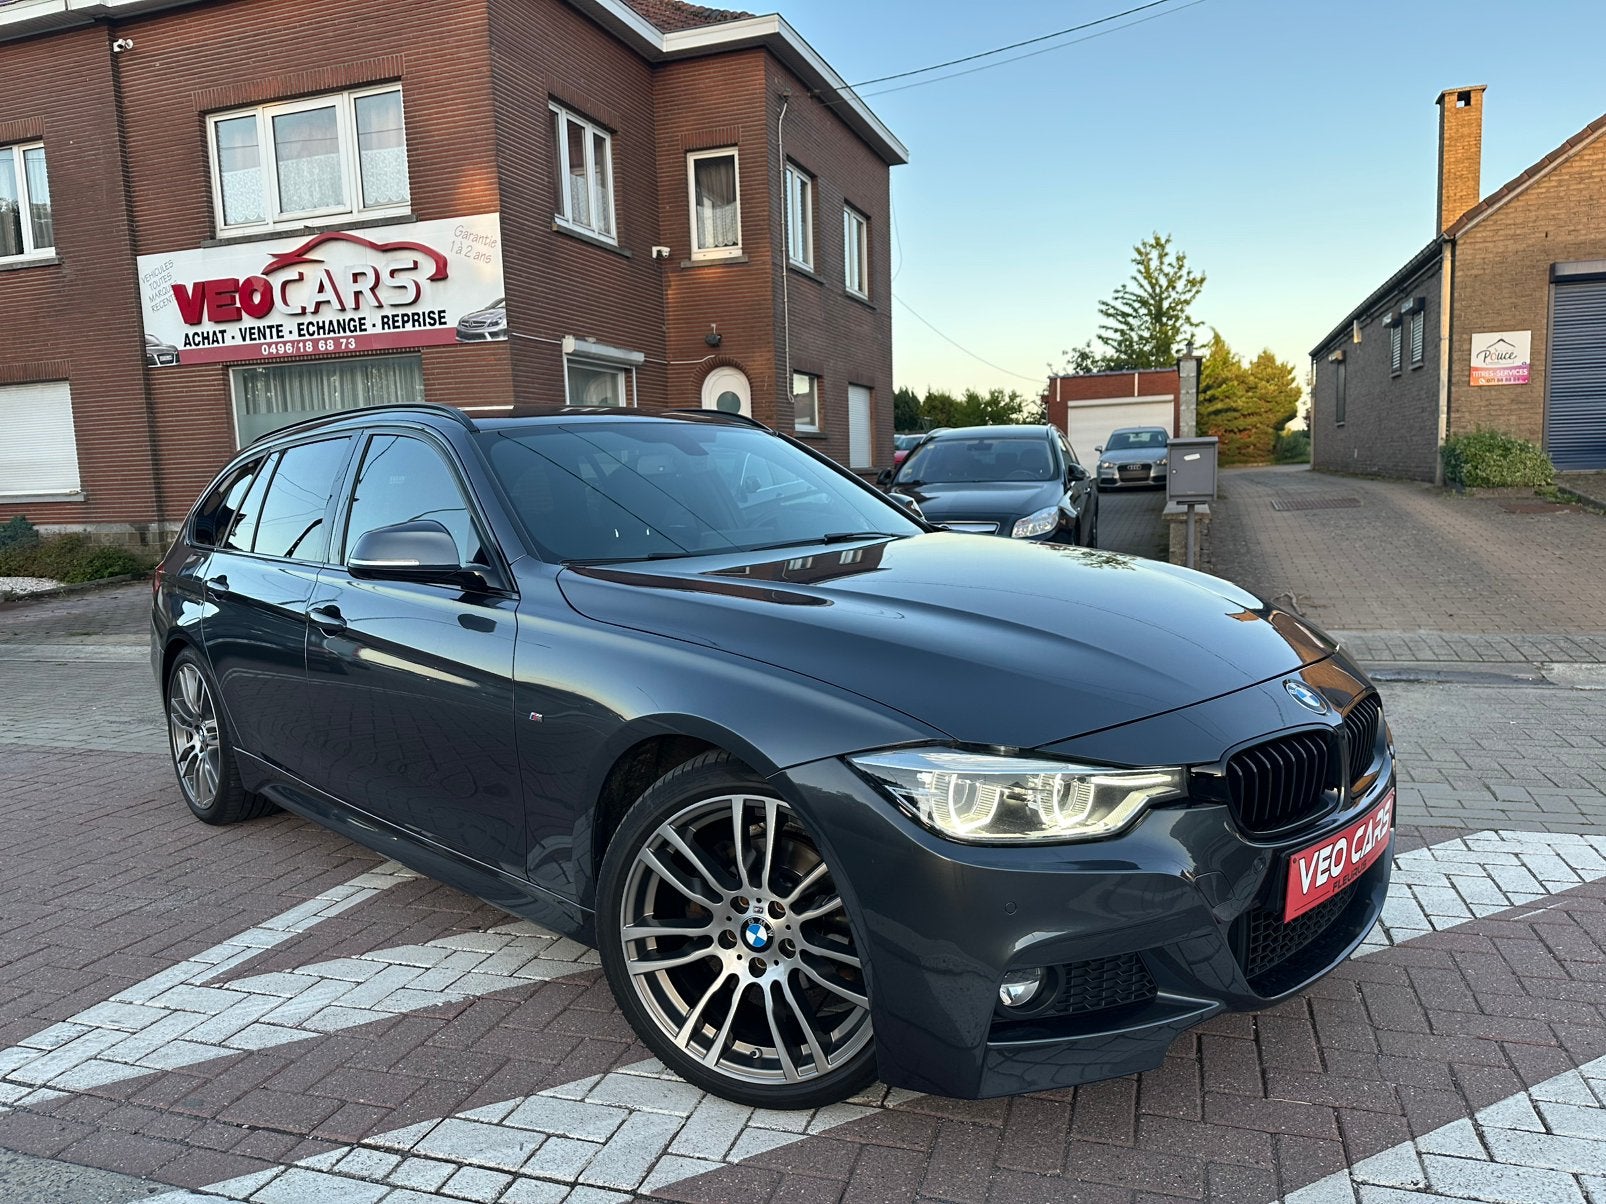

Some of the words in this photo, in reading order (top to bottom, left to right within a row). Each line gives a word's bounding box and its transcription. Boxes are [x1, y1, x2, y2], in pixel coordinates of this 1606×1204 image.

[454, 225, 497, 248] Garantie
[464, 245, 473, 258] 2
[473, 251, 492, 264] ans
[149, 272, 172, 291] TOUTES
[149, 280, 176, 303] MARQU
[172, 275, 274, 325] VEO
[274, 259, 423, 316] CARS
[183, 329, 227, 348] ACHAT
[239, 323, 284, 342] VENTE
[297, 316, 367, 338] ECHANGE
[381, 309, 447, 331] REPRISE
[261, 340, 313, 355] 0496/18
[318, 339, 334, 351] 68
[340, 338, 356, 349] 73
[1299, 837, 1347, 895] VEO
[1351, 799, 1392, 864] CARS
[1332, 862, 1367, 892] FLEURUS
